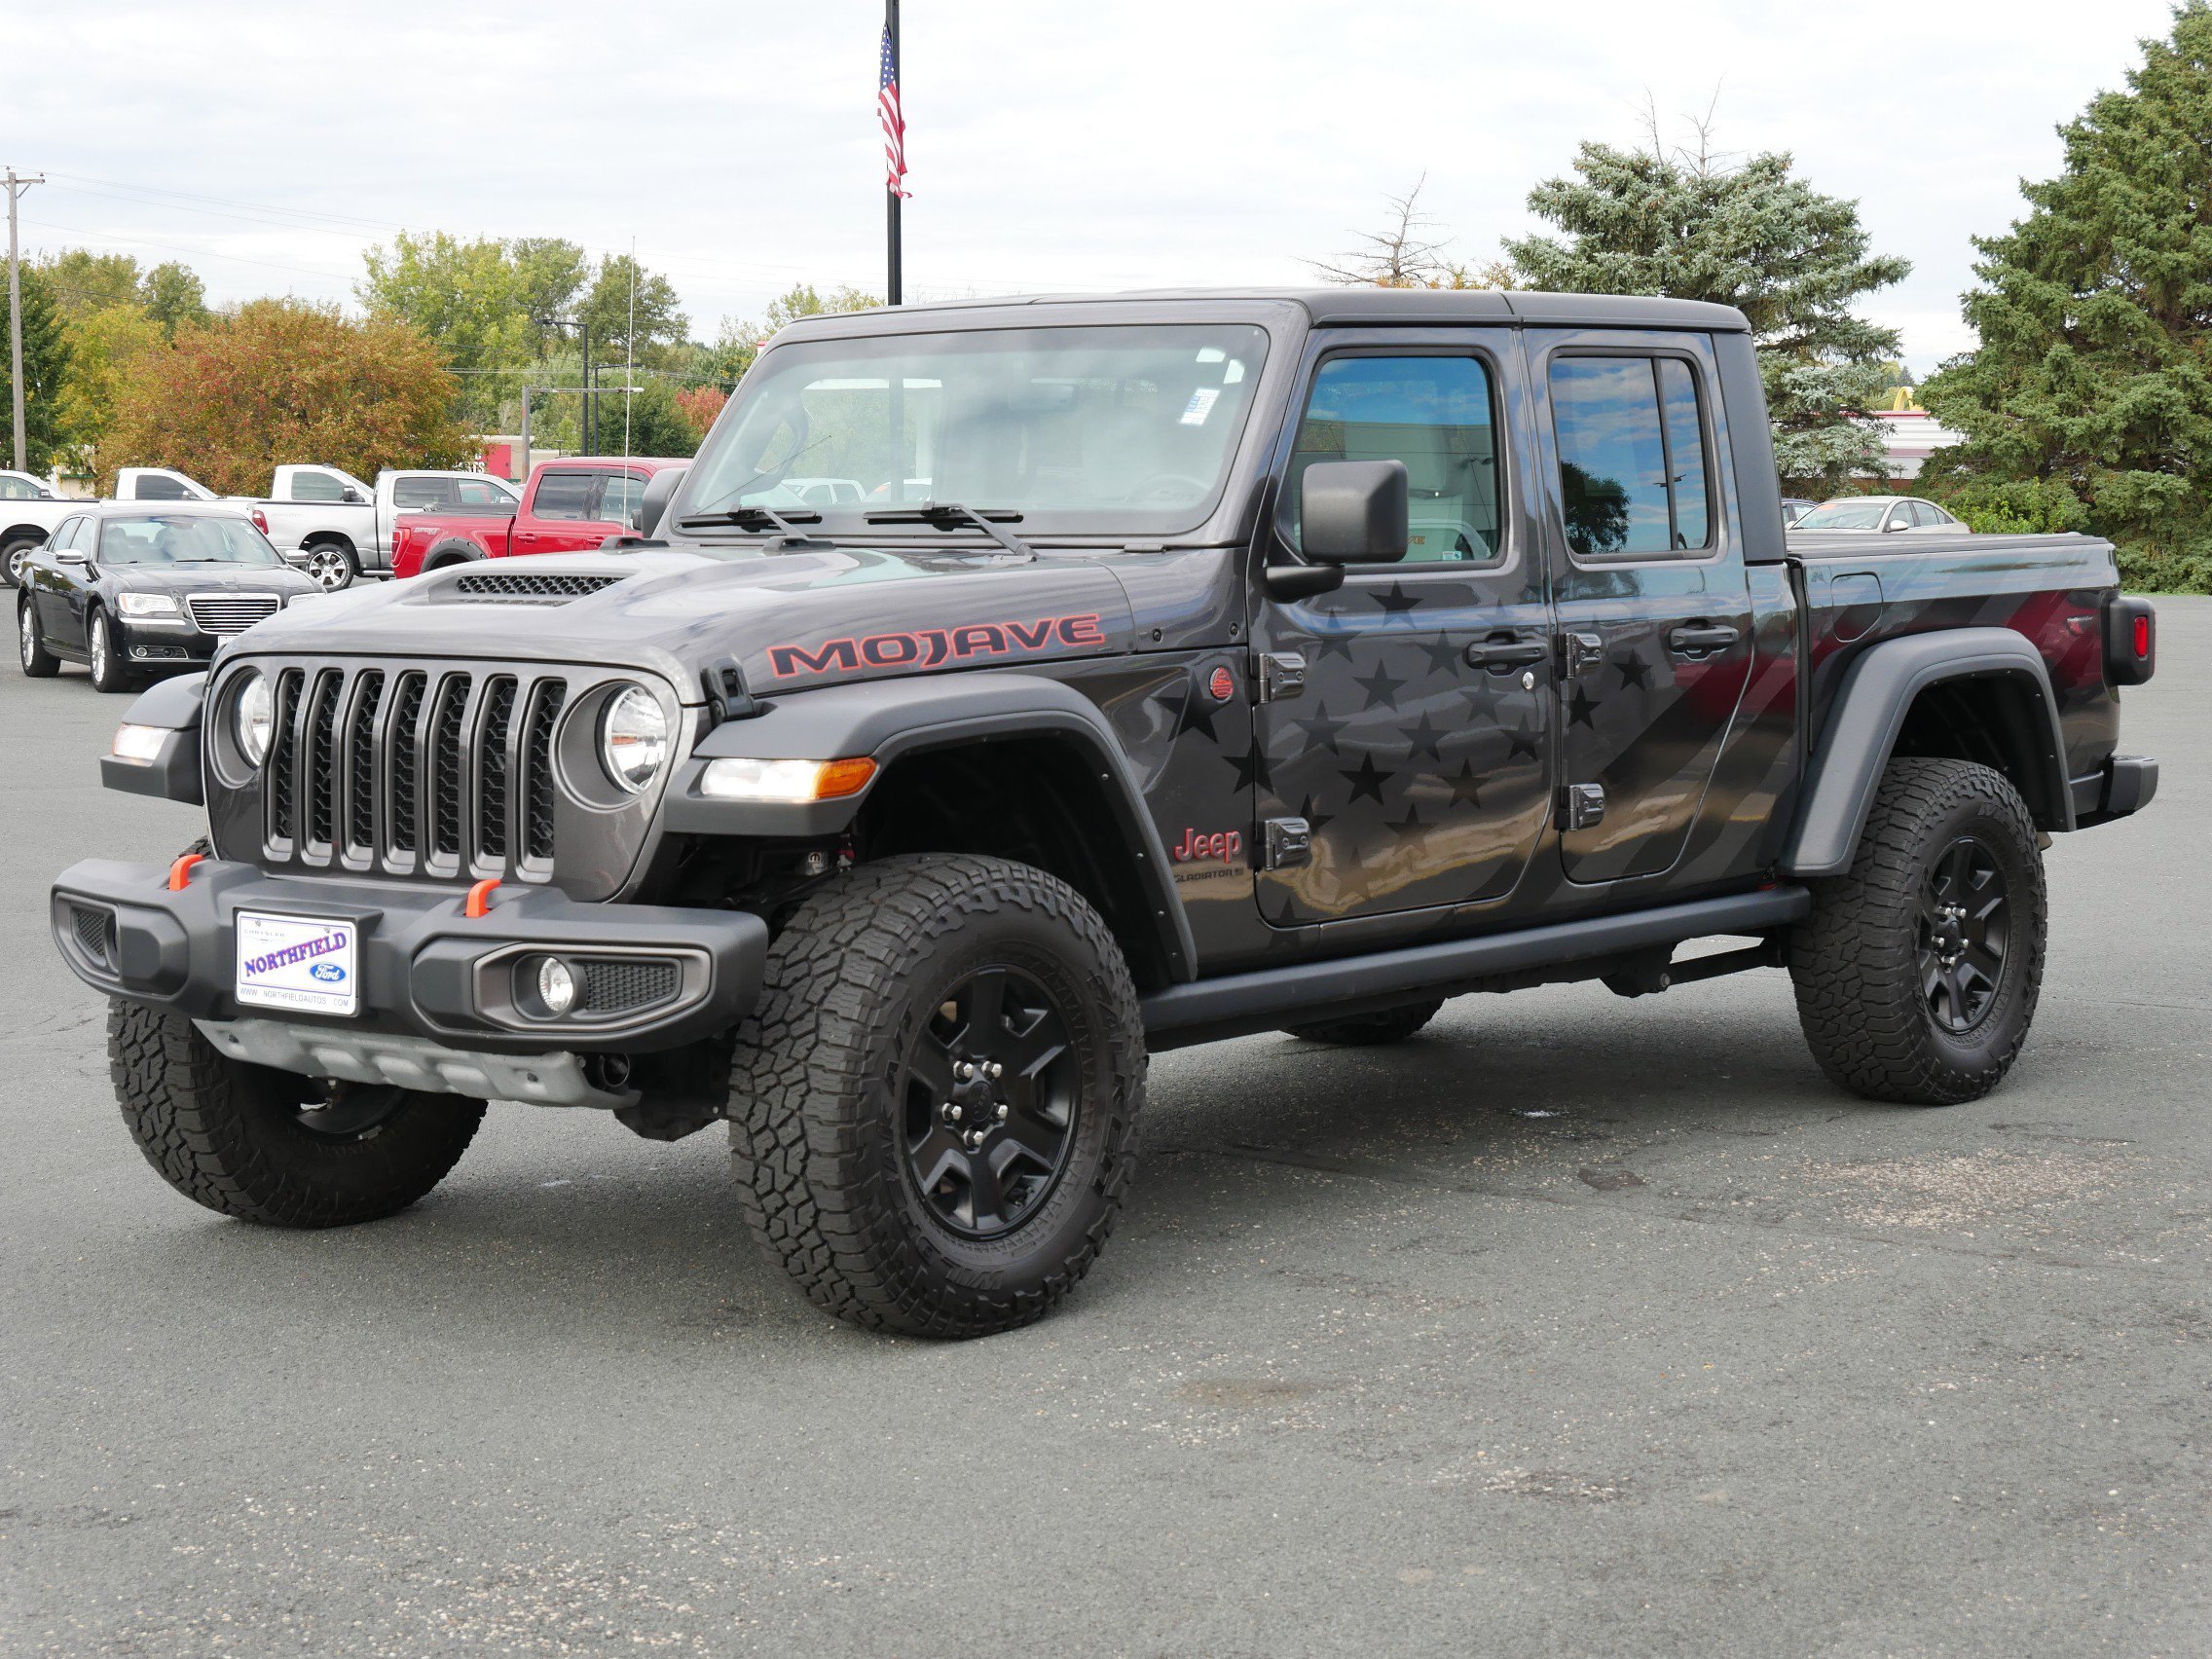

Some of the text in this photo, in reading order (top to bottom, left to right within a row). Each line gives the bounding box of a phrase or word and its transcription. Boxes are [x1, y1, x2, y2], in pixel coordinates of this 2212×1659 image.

[766, 612, 1106, 679] MOJAVE
[1173, 828, 1242, 864] Jeep
[243, 932, 348, 977] NORTHFIELD
[313, 963, 342, 981] Ford
